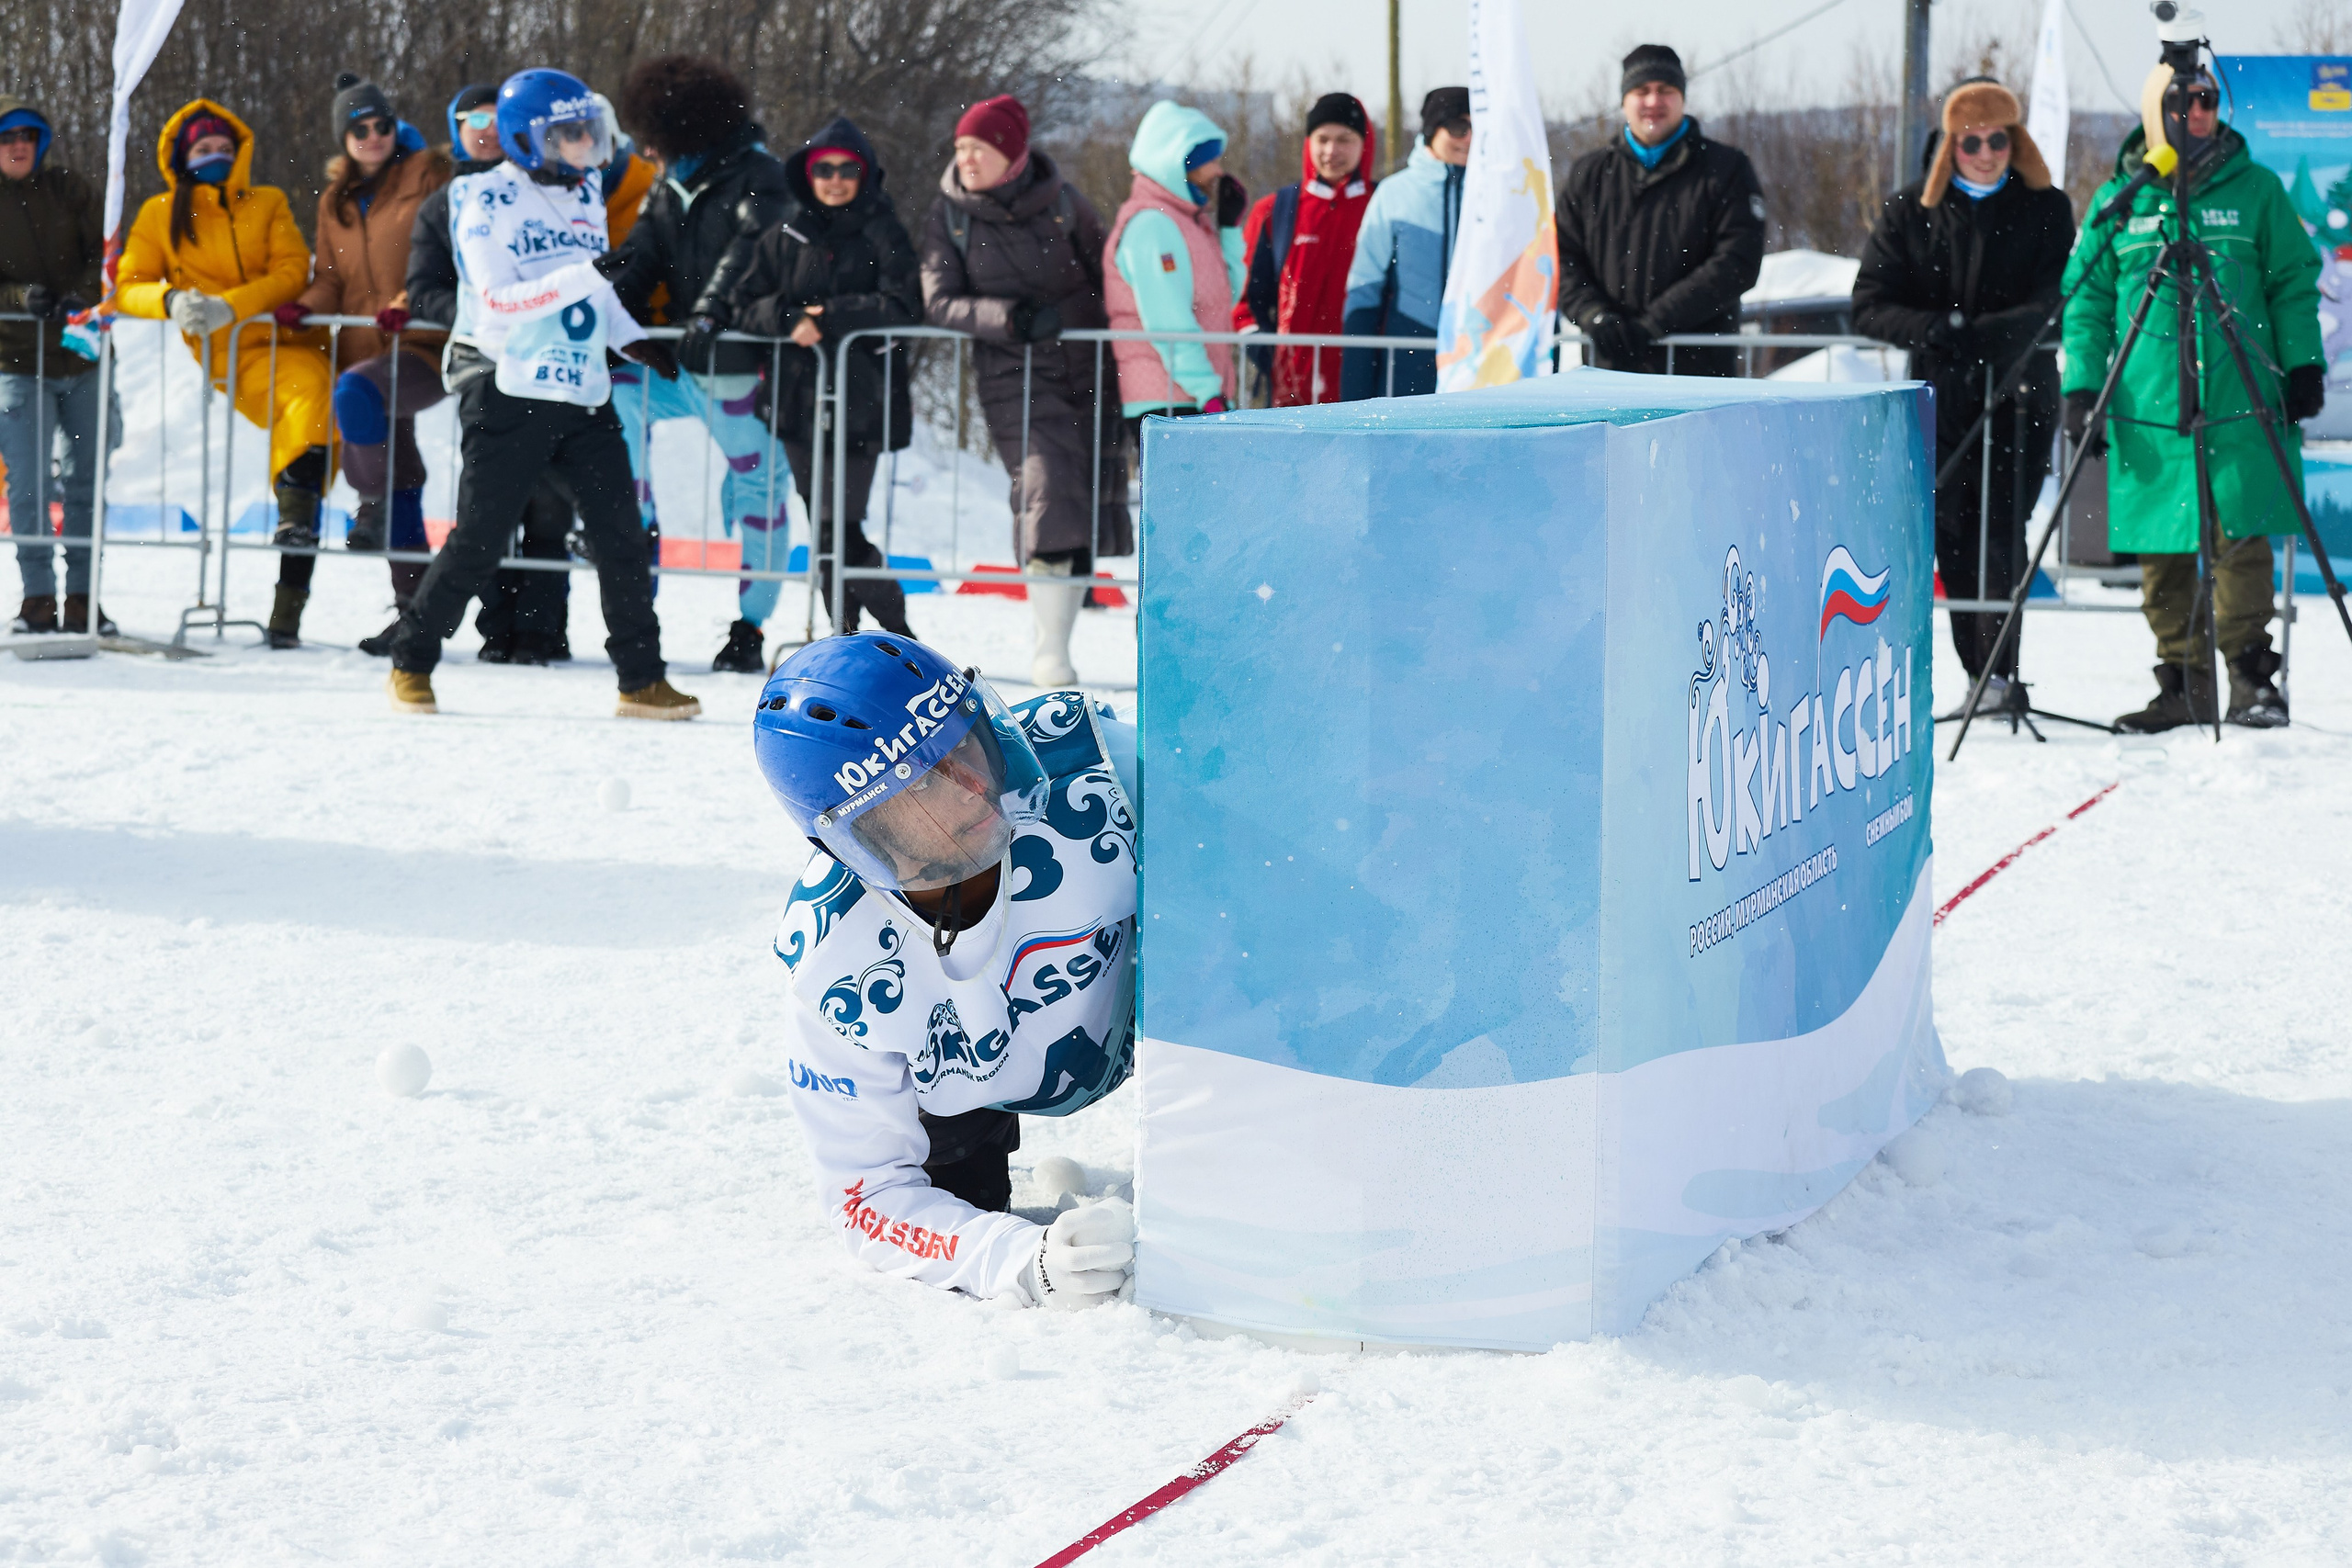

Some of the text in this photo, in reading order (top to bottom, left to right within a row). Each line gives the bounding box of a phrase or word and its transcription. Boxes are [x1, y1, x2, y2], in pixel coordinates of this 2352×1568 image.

[1687, 643, 1911, 883] ЮКИГАССЕН
[837, 782, 888, 818] МУРМАНСК
[1689, 843, 1838, 958] РОССИЯ, МУРМАНСКАЯ ОБЛАСТЬ
[788, 1057, 858, 1098] UNO
[976, 1052, 1010, 1082] REGION
